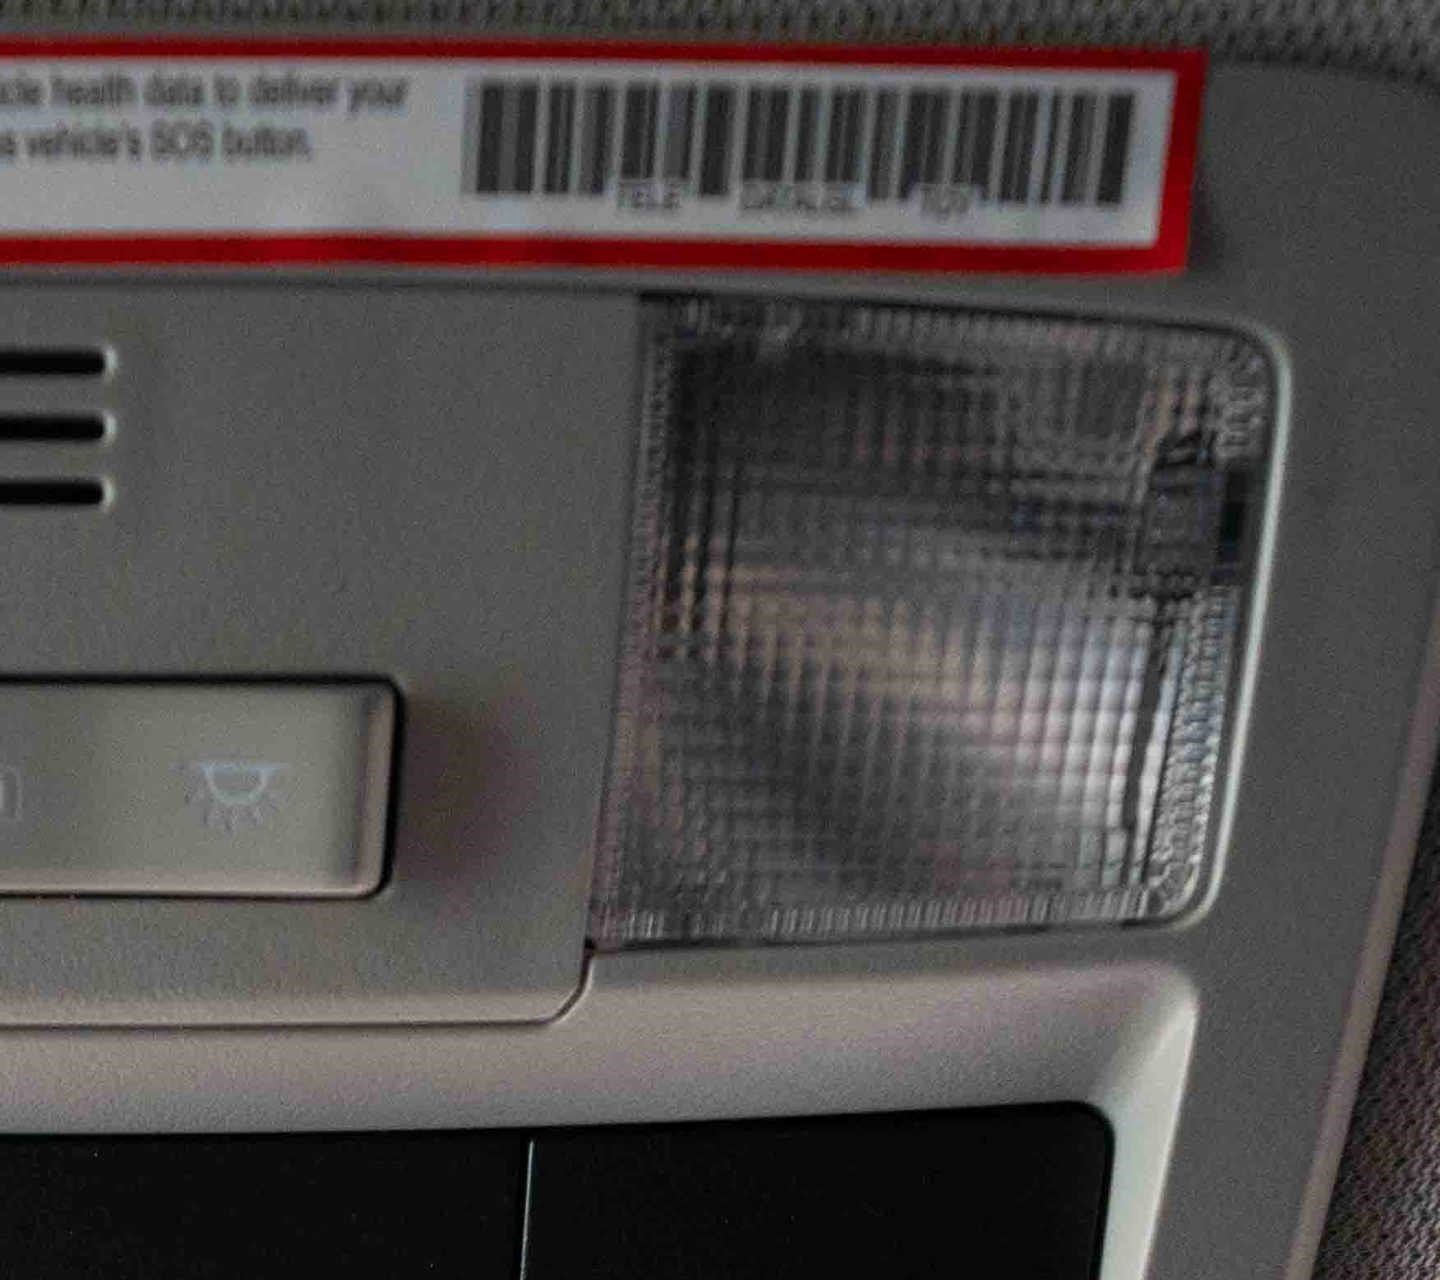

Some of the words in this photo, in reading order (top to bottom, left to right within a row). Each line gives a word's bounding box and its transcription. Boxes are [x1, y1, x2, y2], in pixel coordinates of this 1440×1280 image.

[49, 75, 136, 108] health
[142, 75, 207, 108] data
[213, 75, 241, 106] to
[247, 74, 339, 106] deliver
[347, 78, 408, 116] your
[149, 120, 215, 160] SOS
